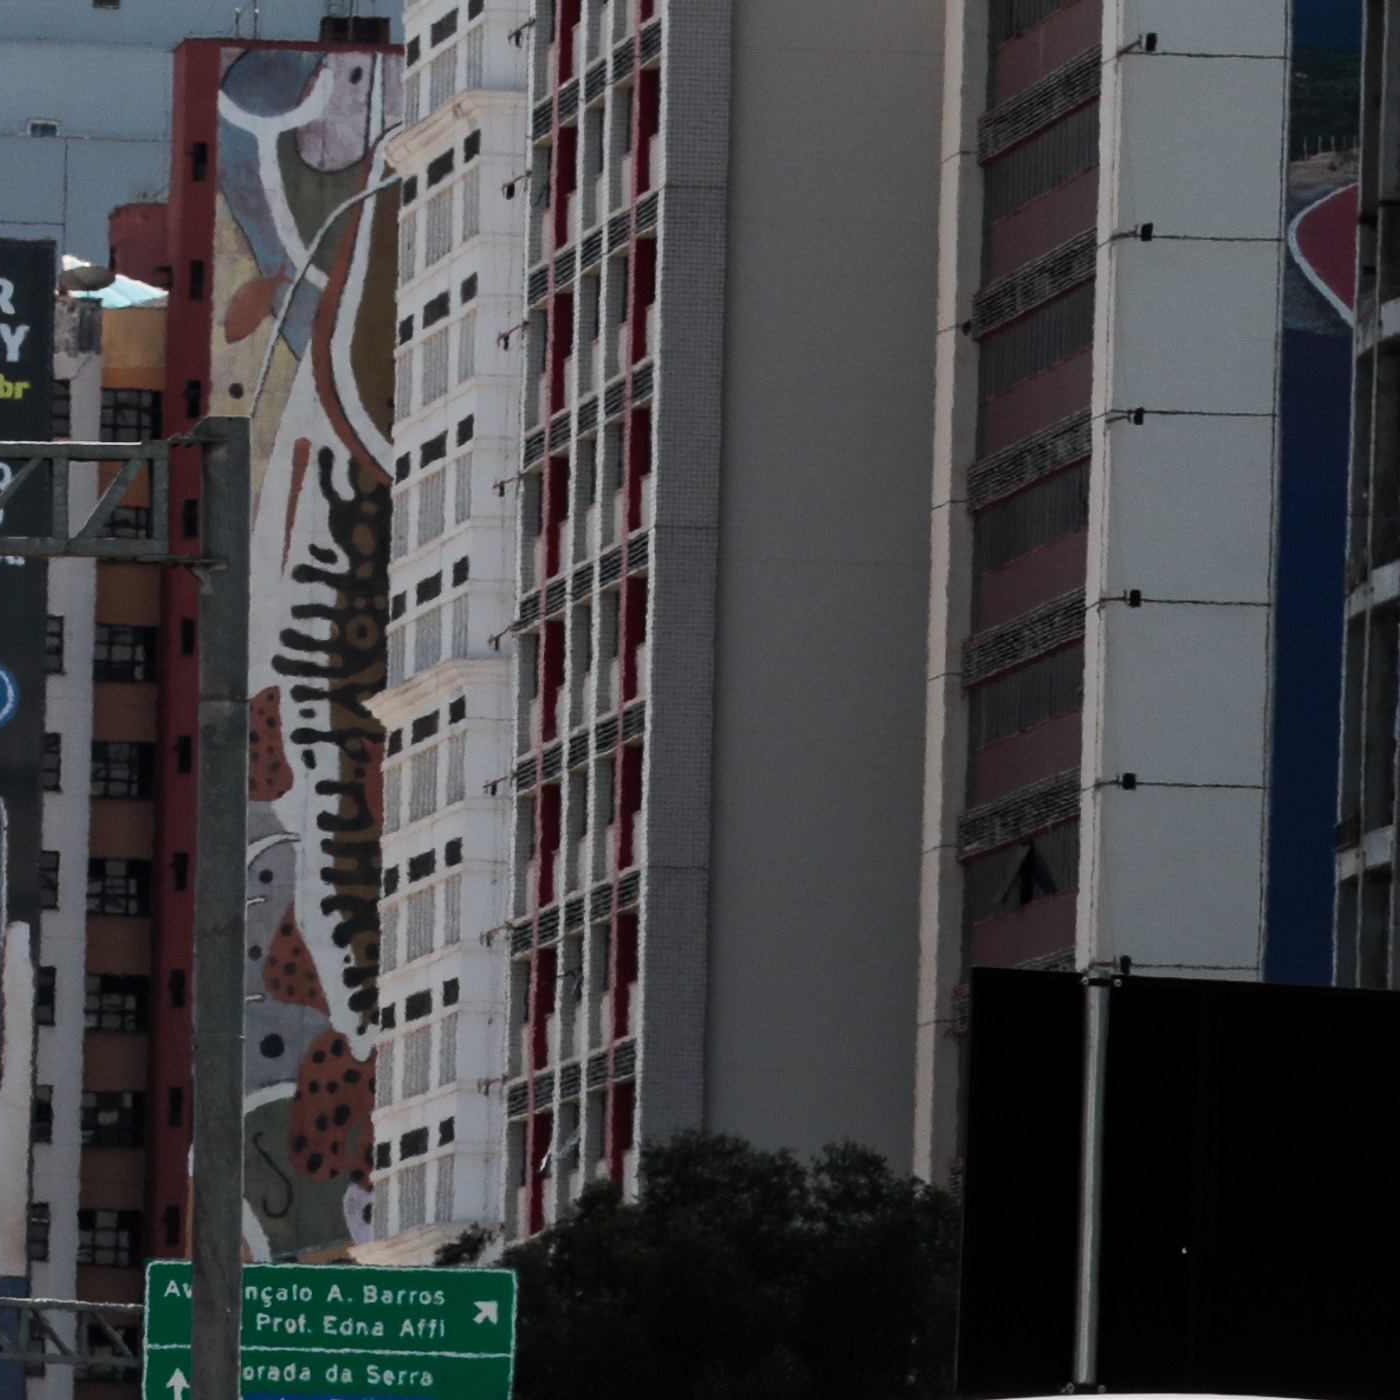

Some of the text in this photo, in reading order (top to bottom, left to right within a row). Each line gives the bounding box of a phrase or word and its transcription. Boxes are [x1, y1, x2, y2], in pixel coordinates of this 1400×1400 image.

[244, 1284, 313, 1308] nçalo
[327, 1285, 353, 1303] A.
[363, 1285, 446, 1306] Barros
[256, 1312, 313, 1334] Prof.
[323, 1315, 385, 1337] Edna
[242, 1362, 434, 1386] orada da Serra
